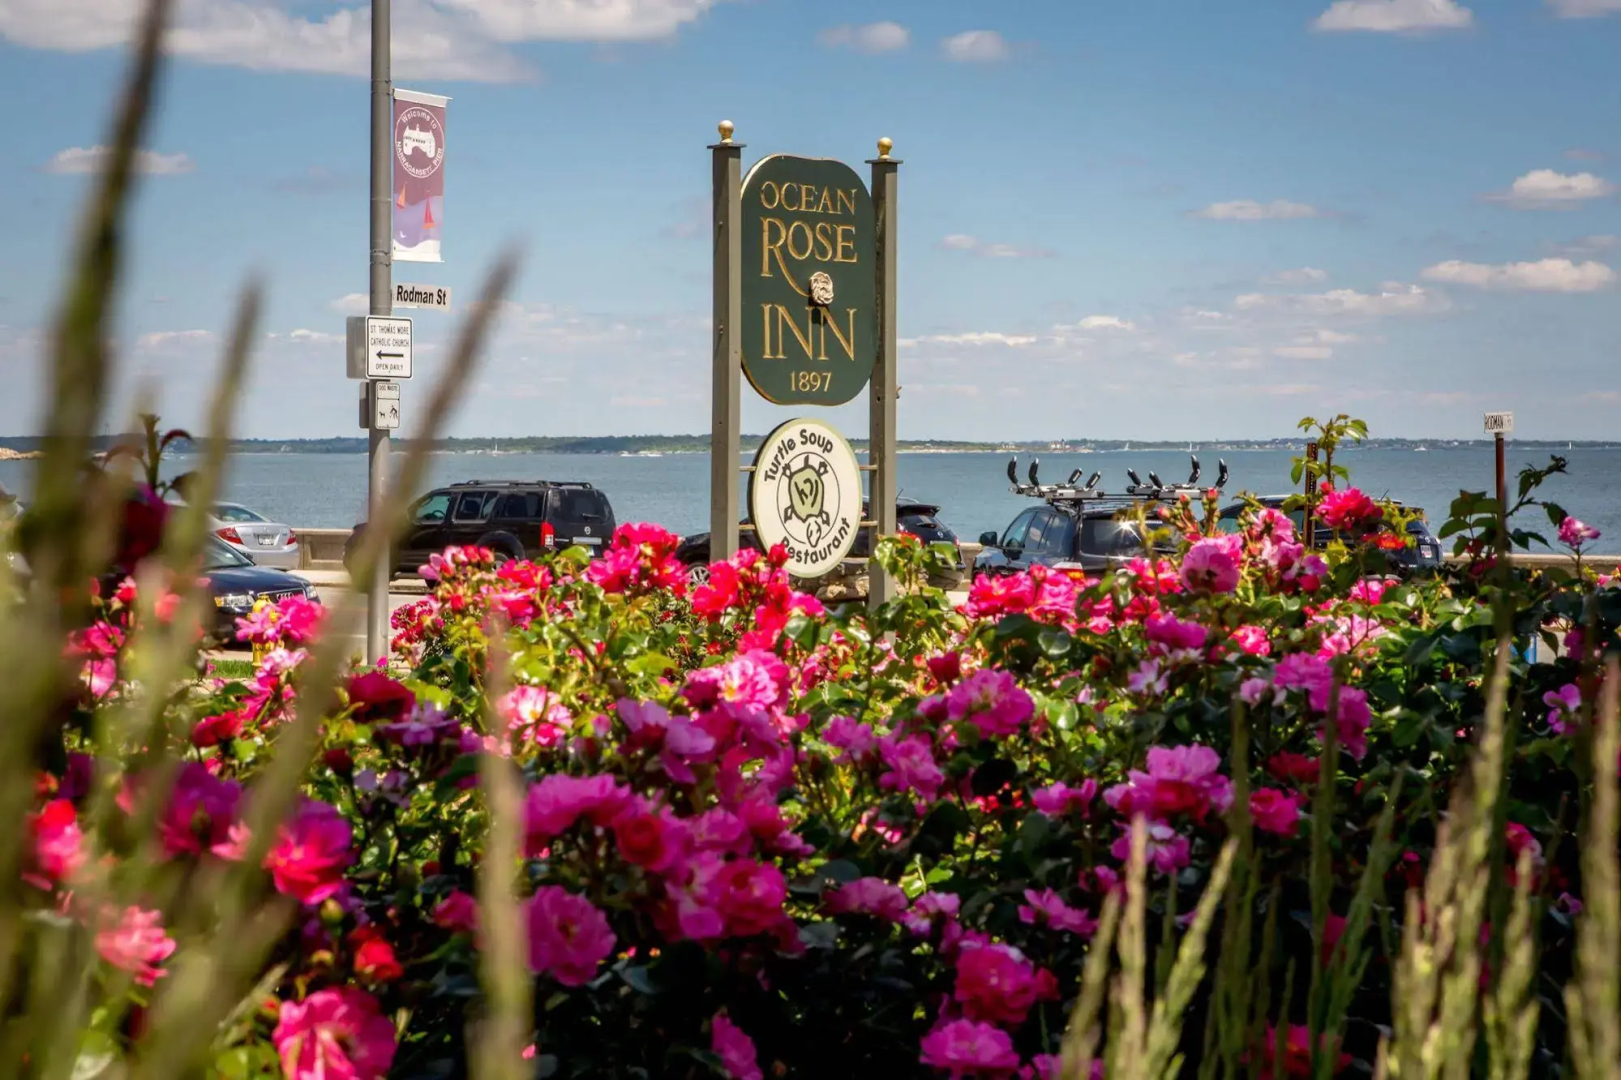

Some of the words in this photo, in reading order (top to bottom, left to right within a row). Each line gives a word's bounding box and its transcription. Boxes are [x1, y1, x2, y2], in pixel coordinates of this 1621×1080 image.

[402, 110, 430, 123] Welcome
[430, 120, 437, 130] to
[433, 148, 442, 166] PIER
[760, 181, 858, 215] OCEAN
[760, 216, 858, 297] ROSE
[396, 285, 434, 305] Rodman
[436, 288, 447, 306] St
[378, 325, 396, 334] THOMAS
[397, 325, 409, 335] MORE
[760, 303, 858, 361] INN
[370, 337, 391, 347] CATHOLIC
[392, 338, 409, 347] CHURCH
[389, 363, 404, 371] DAILY
[790, 371, 832, 392] 1897
[764, 438, 797, 483] Turtle
[800, 428, 834, 454] Soup
[780, 517, 851, 565] Restaurant
